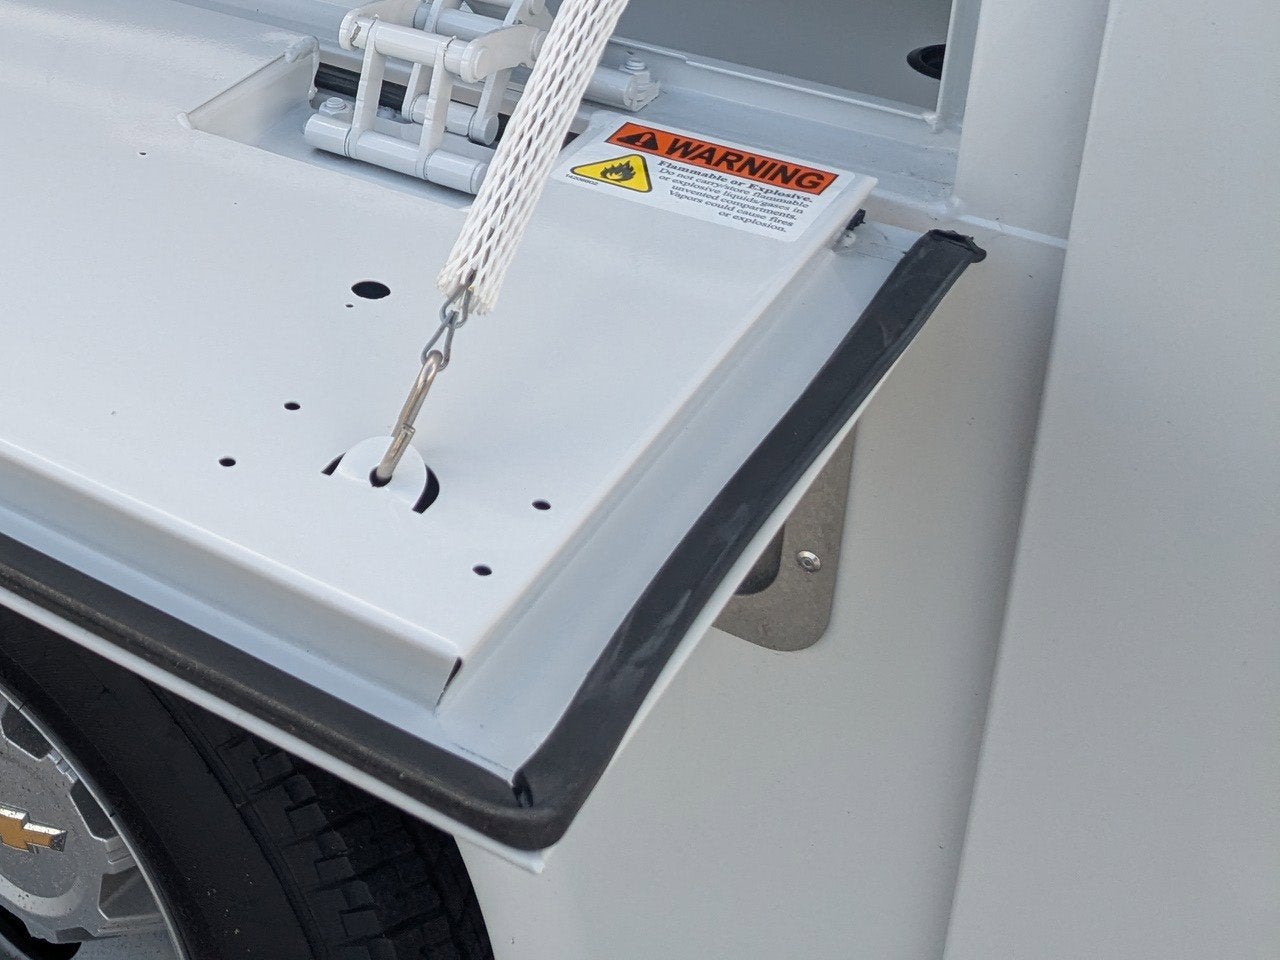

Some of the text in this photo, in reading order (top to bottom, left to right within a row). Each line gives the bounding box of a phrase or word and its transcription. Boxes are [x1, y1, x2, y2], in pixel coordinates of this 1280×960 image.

[664, 137, 825, 190] WARNING
[658, 160, 813, 203] Flammable or Explosive.
[672, 178, 721, 194] explosive
[723, 191, 790, 211] liquids/gases
[695, 177, 750, 195] carry/store
[752, 192, 809, 208] flammable
[668, 190, 794, 227] Vapors could cause fires
[671, 185, 797, 220] unvented compartments.
[732, 214, 787, 232] explosion.
